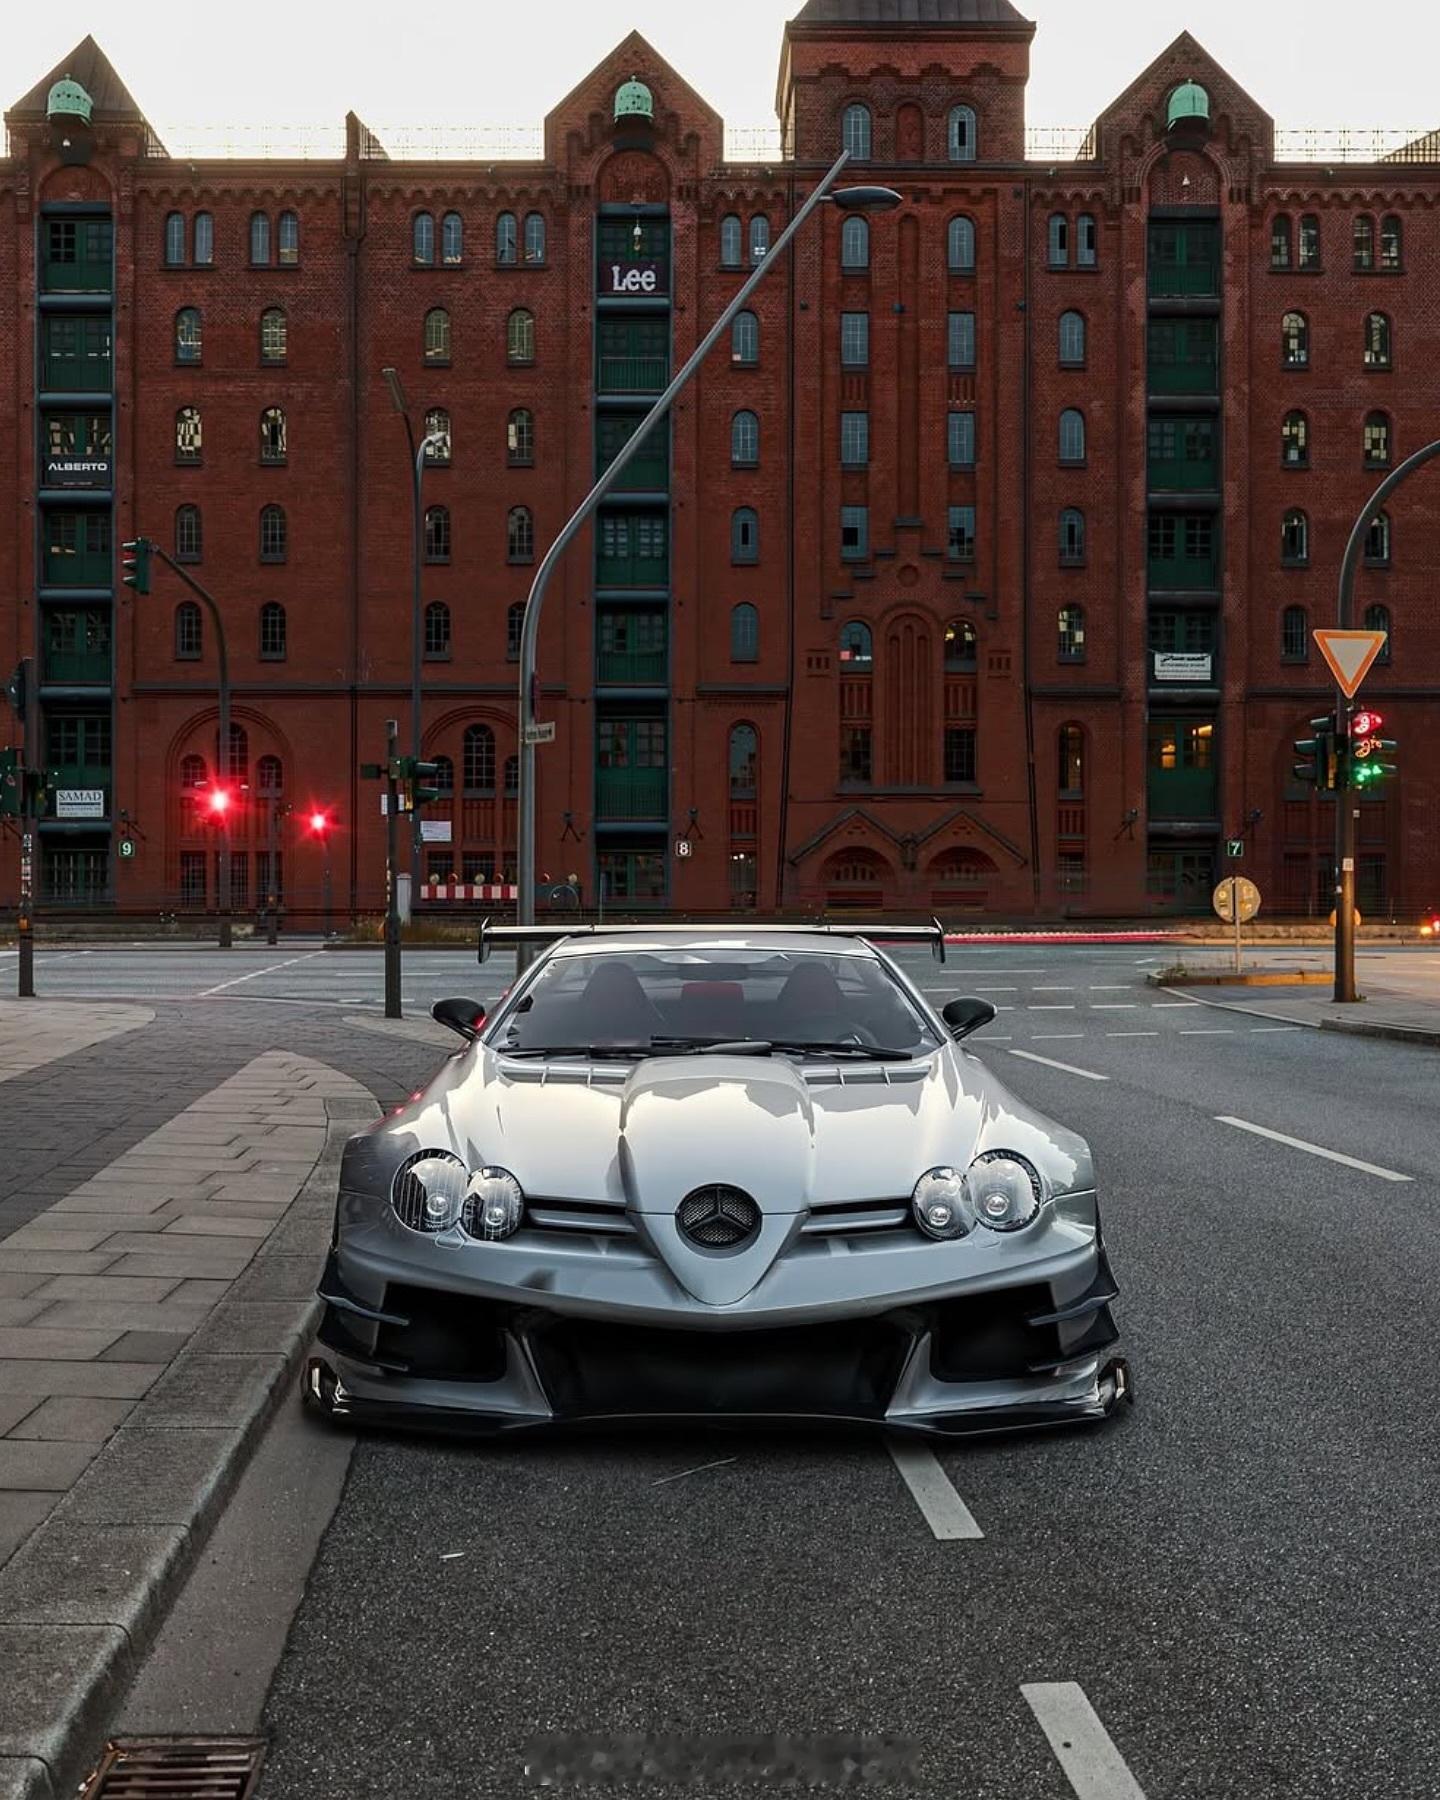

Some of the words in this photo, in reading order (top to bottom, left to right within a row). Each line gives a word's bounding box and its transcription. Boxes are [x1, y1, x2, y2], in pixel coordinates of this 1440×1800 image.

[611, 265, 656, 291] Lee
[48, 462, 108, 471] ALBERTO
[58, 791, 102, 801] SAMAD
[122, 842, 132, 855] 9
[679, 842, 689, 855] 8
[1231, 842, 1240, 855] 7
